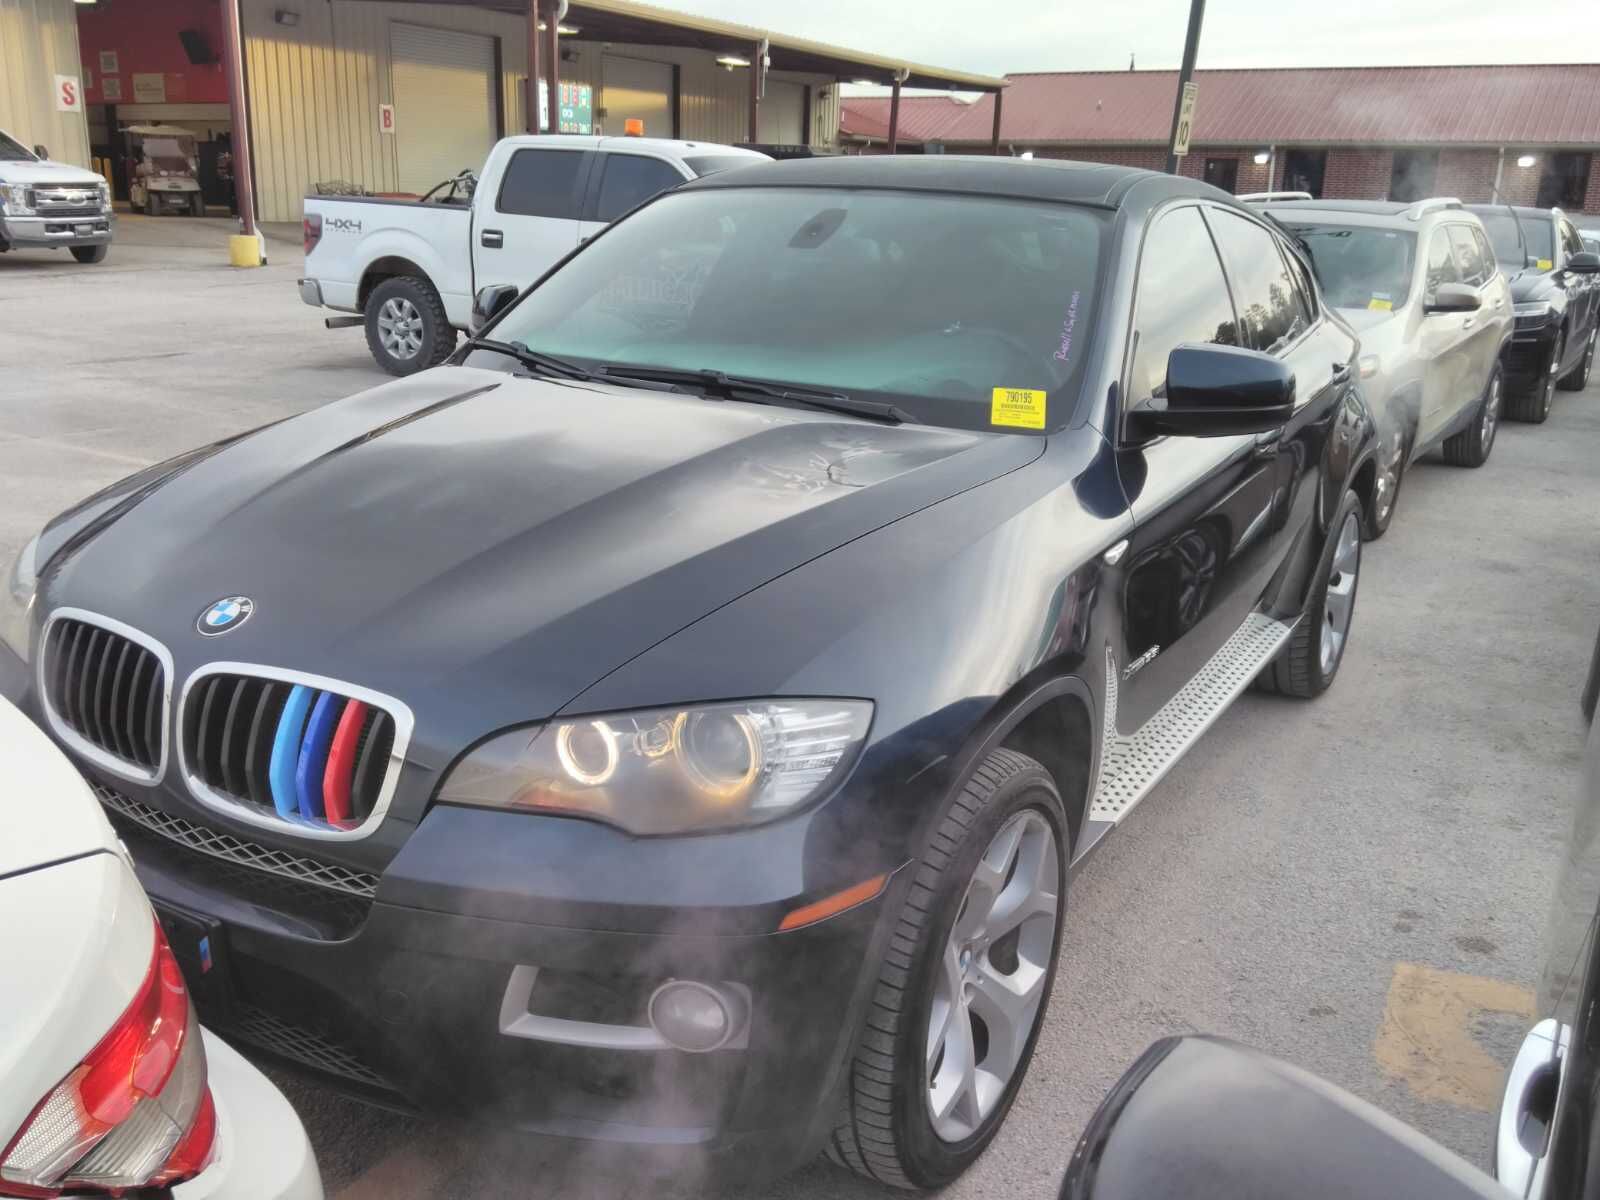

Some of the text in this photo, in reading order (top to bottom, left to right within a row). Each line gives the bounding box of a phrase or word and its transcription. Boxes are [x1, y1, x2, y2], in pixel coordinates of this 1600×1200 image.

[62, 81, 76, 106] S
[383, 109, 393, 129] B
[1178, 120, 1189, 147] 10
[1006, 391, 1033, 404] 790195
